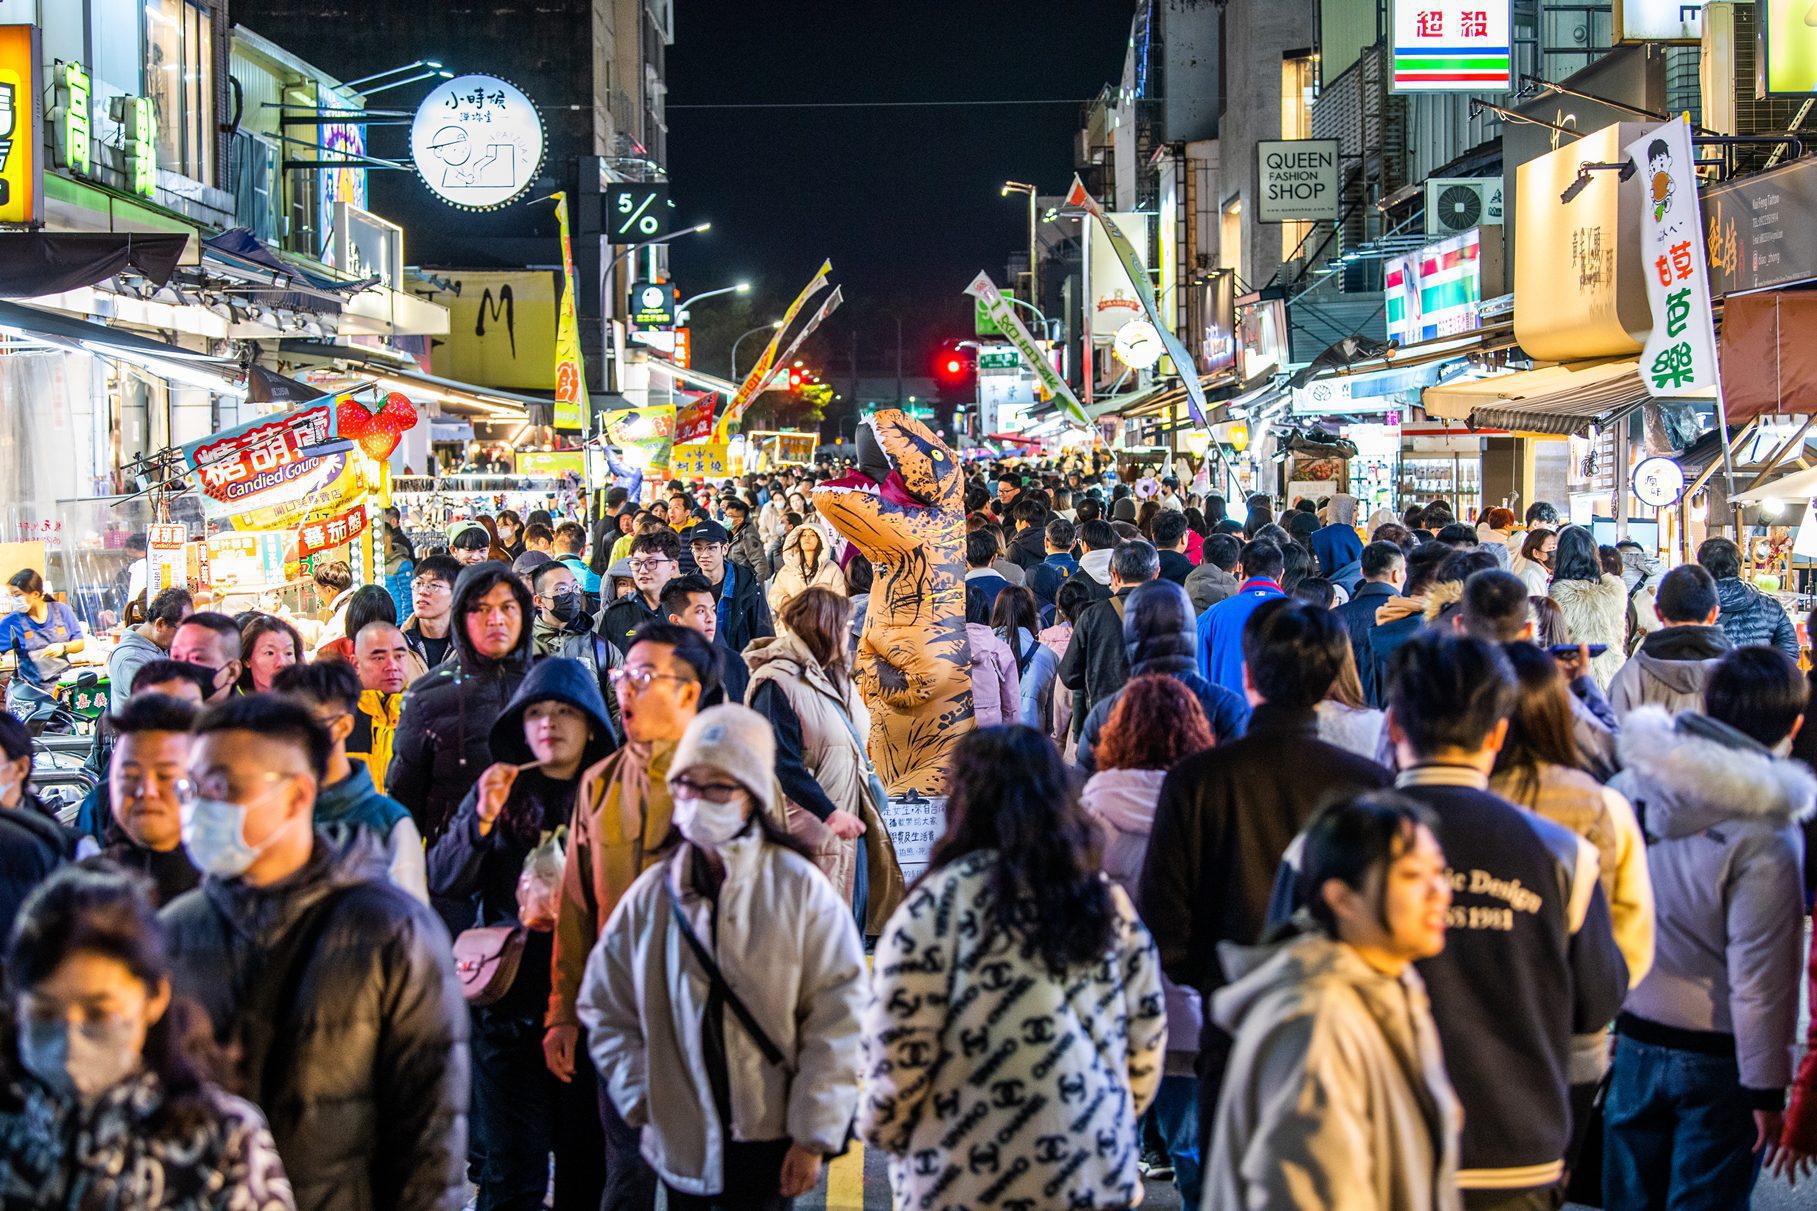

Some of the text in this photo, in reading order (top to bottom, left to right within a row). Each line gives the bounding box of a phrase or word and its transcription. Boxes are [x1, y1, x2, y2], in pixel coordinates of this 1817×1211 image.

[445, 87, 506, 110] 小時候
[1266, 152, 1332, 169] QUEEN
[1269, 171, 1318, 181] FASHION
[1268, 183, 1326, 200] SHOP
[197, 410, 329, 487] 糖葫蘆
[226, 465, 284, 499] Candied
